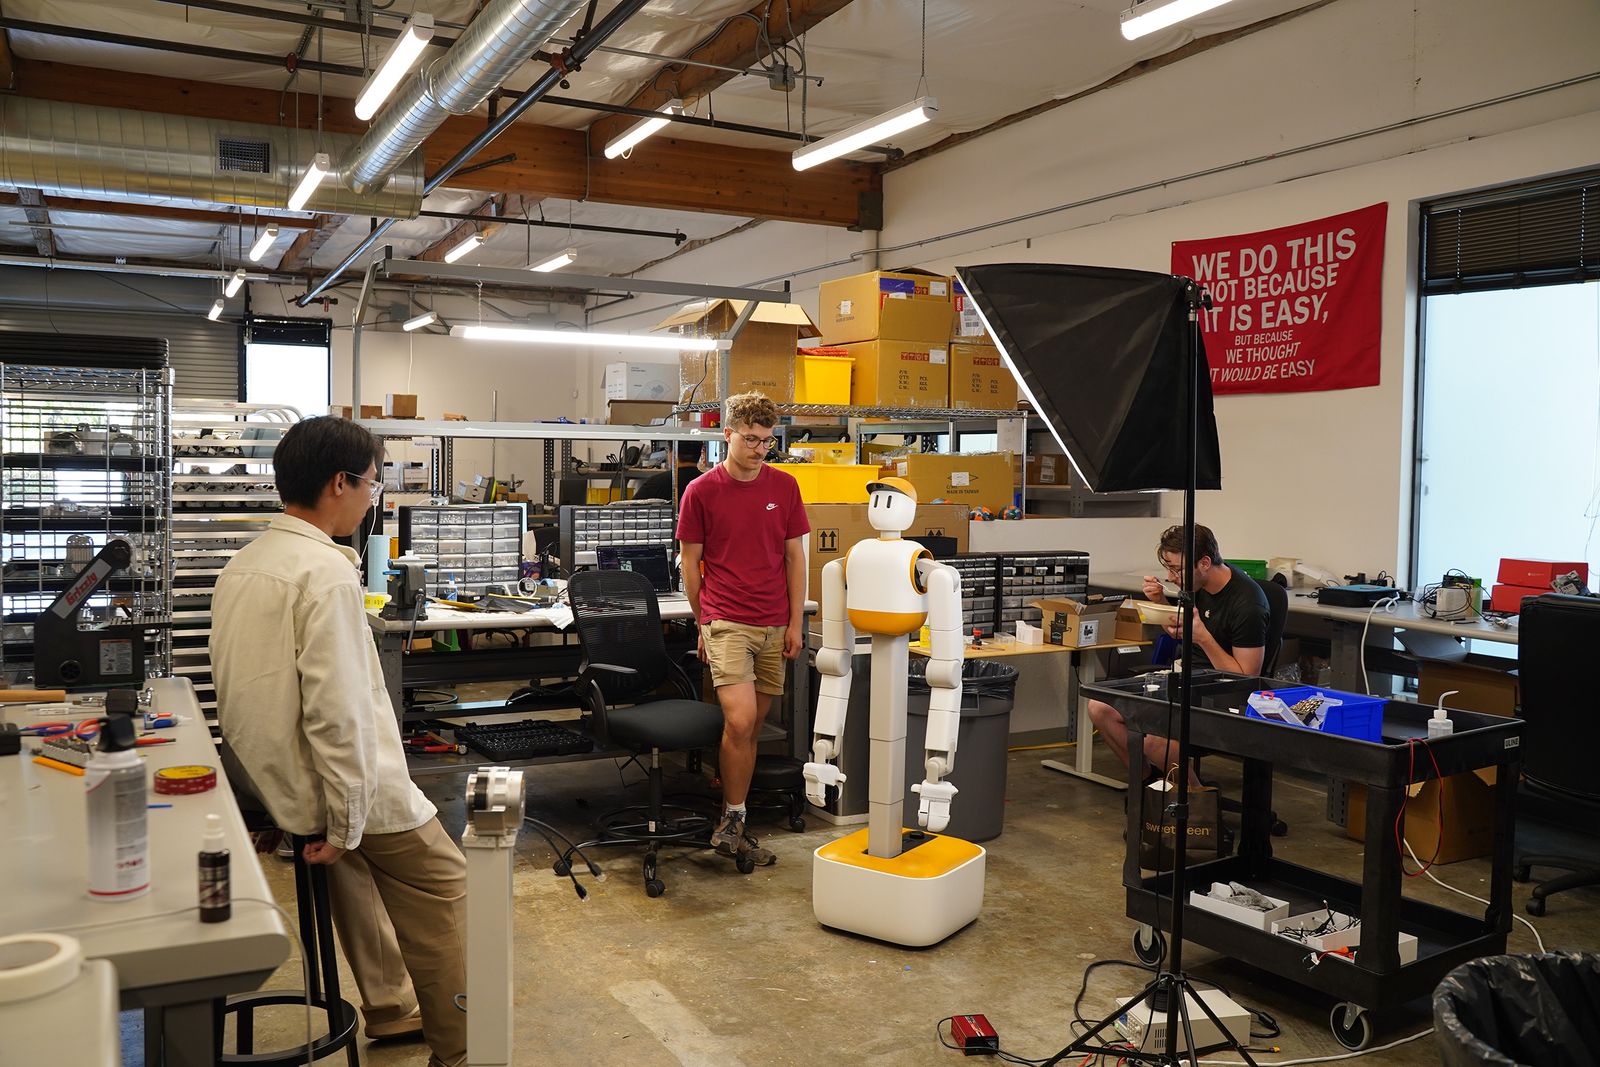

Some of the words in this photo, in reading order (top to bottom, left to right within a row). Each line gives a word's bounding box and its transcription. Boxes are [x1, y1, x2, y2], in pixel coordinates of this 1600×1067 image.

[1192, 251, 1231, 281] WE
[1239, 244, 1278, 277] DO
[1286, 228, 1357, 269] THIS
[1202, 279, 1239, 302] NOT
[1244, 263, 1340, 300] BECAUSE
[1204, 306, 1224, 333] IT
[1229, 304, 1252, 331] IS
[1261, 292, 1329, 329] EASY,
[1234, 334, 1252, 346] BUT
[1253, 330, 1294, 345] BECAUSE
[1225, 349, 1243, 364] WE
[1246, 342, 1301, 363] THOUGHT
[1221, 366, 1262, 383] WOULD
[1262, 364, 1279, 380] BE
[1280, 359, 1315, 379] EASY
[65, 570, 98, 606] Grizzly
[1505, 737, 1519, 748] ULINE
[1145, 822, 1209, 836] sweeteen
